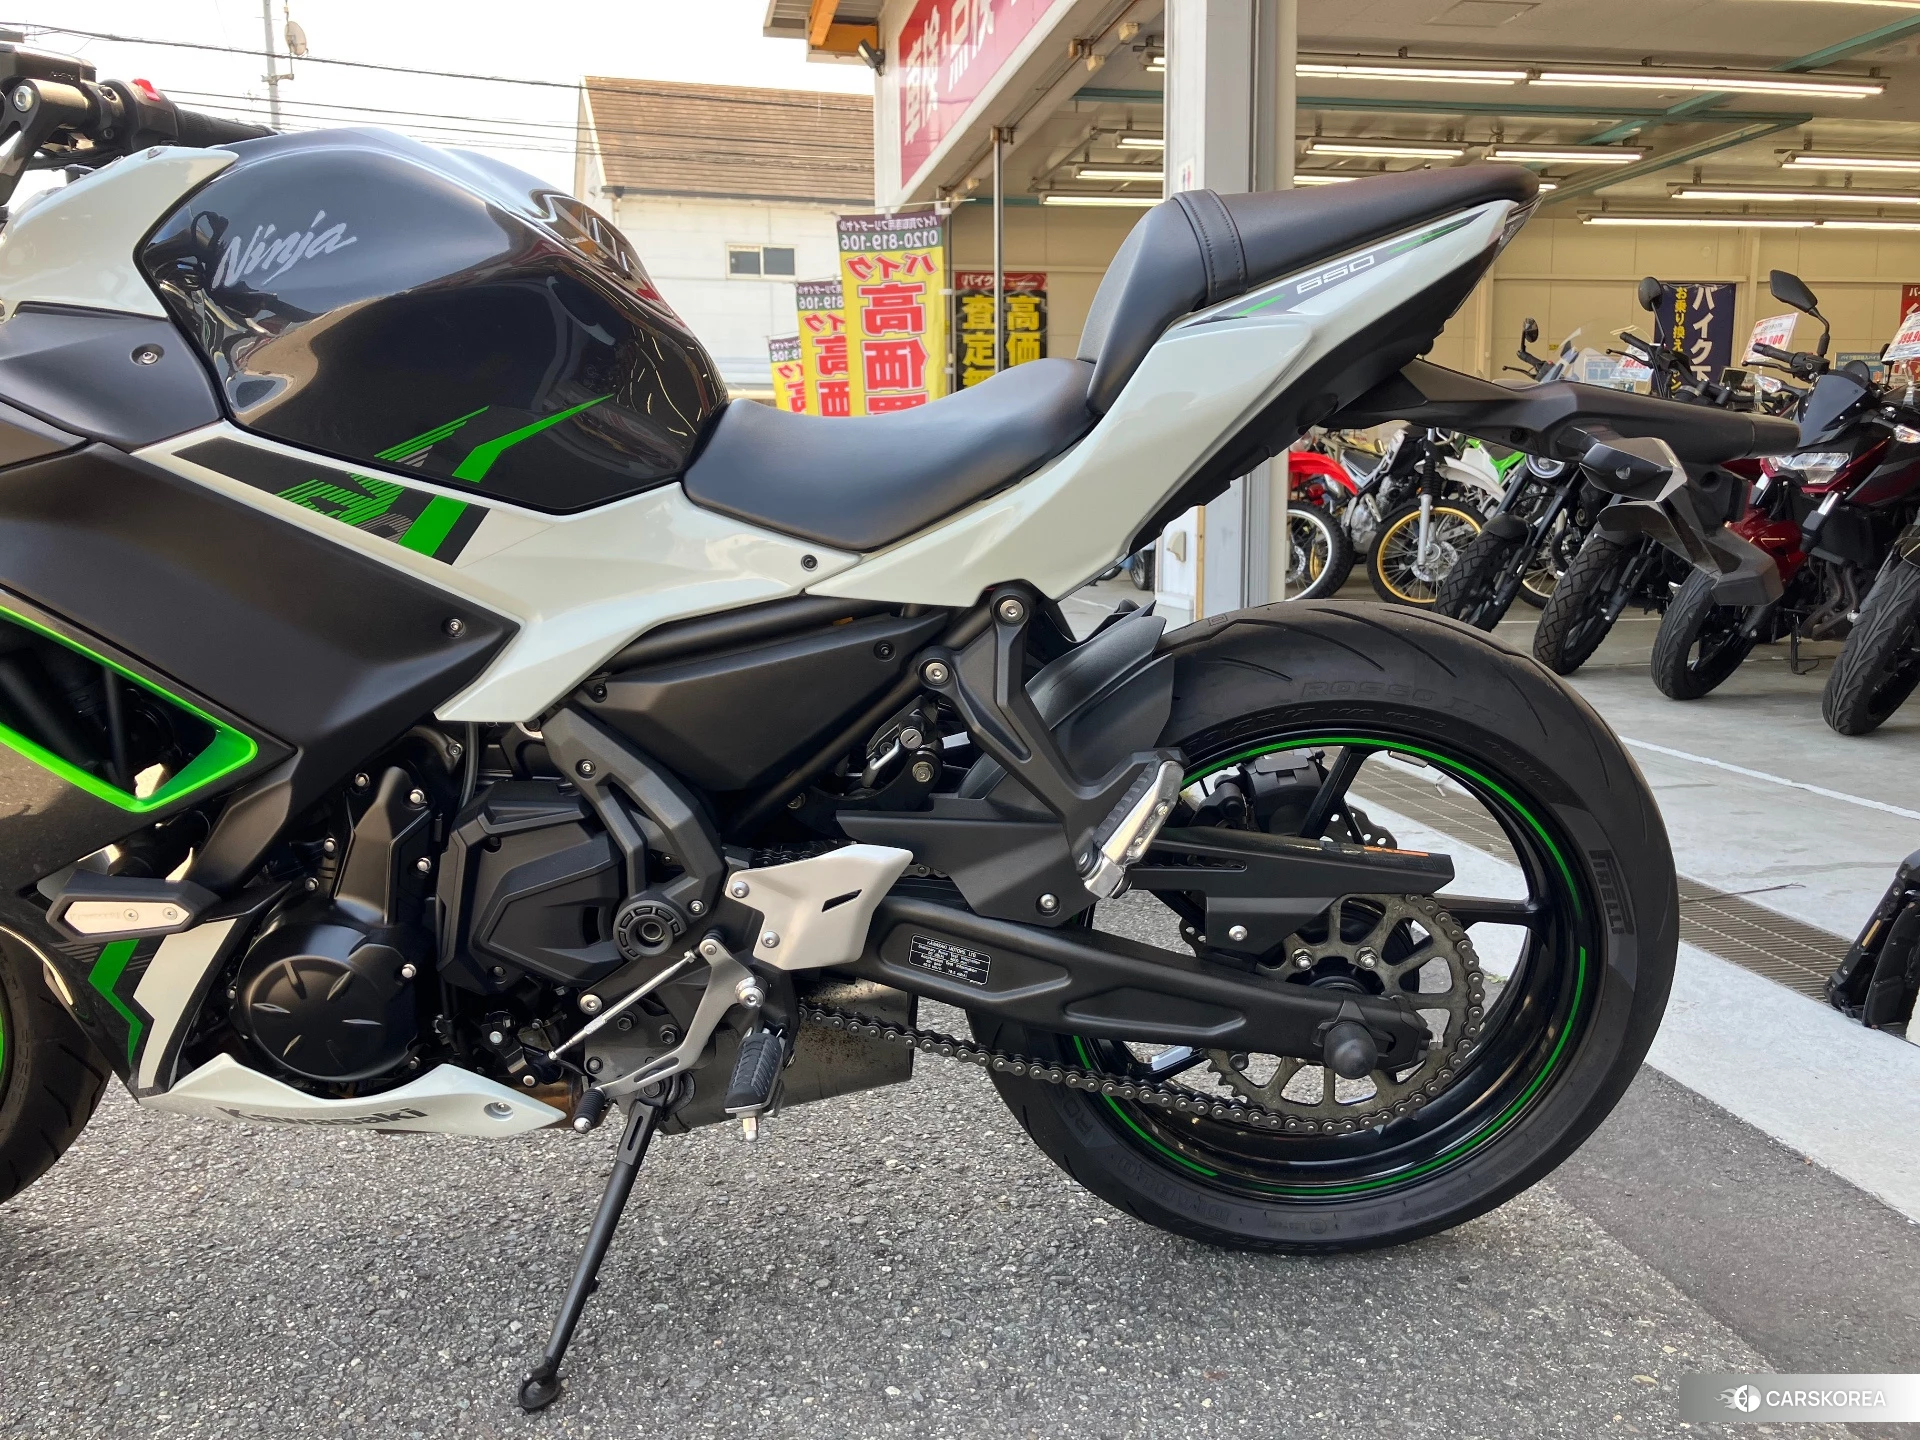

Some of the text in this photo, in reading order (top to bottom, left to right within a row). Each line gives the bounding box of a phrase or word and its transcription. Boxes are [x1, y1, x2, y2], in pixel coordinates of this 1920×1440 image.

[211, 210, 357, 290] Ninja
[1297, 255, 1374, 294] 650
[961, 274, 1005, 287] バイク
[1004, 295, 1041, 367] 高価
[1302, 680, 1438, 701] ROSSO
[1588, 849, 1634, 935] PIRELLI
